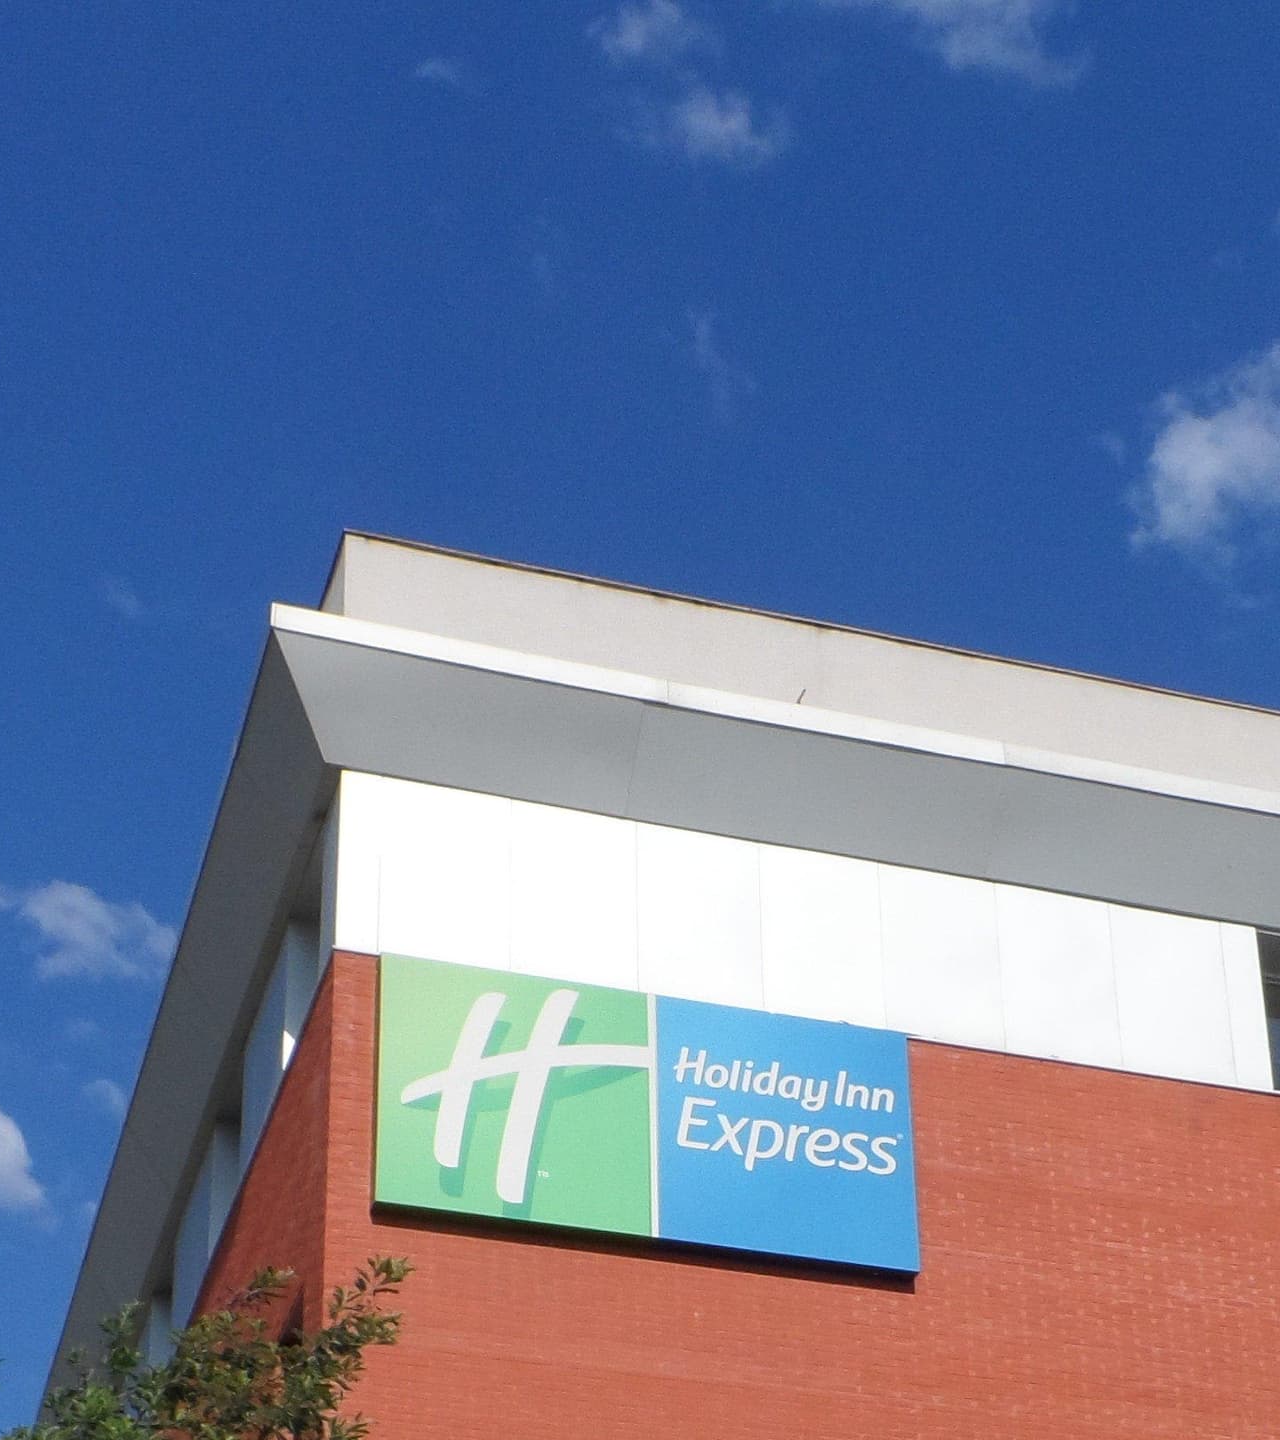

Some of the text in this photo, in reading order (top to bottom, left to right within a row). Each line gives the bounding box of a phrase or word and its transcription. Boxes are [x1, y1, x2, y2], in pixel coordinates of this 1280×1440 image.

[673, 1046, 895, 1113] Holiday Inn
[676, 1095, 898, 1175] Express
